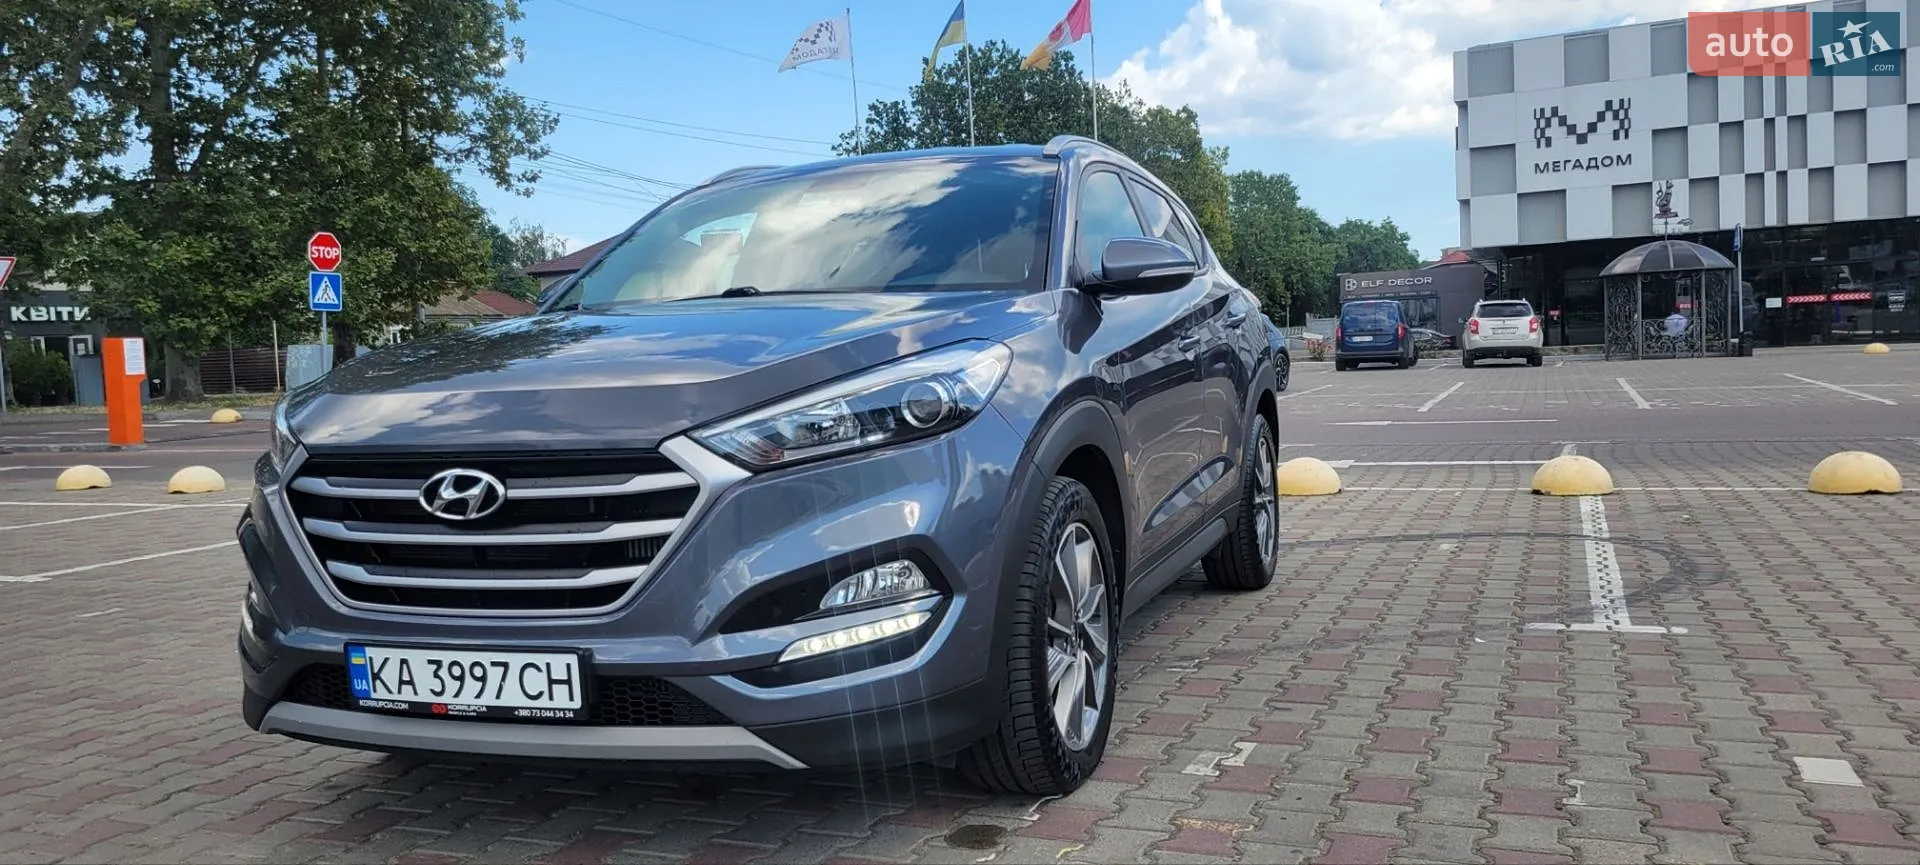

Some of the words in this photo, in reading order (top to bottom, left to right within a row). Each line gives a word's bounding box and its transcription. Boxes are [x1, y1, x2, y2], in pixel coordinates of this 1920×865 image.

[1534, 153, 1632, 174] МЕГАДОМ
[311, 245, 339, 259] STOP
[1361, 280, 1383, 288] ELF
[1388, 277, 1432, 286] DECOR
[354, 678, 368, 691] UA
[368, 656, 419, 697] KA
[427, 659, 510, 701] 3997
[518, 662, 574, 702] CH
[514, 709, 531, 717] +380
[531, 709, 540, 717] 73
[541, 710, 554, 718] 044
[555, 710, 564, 718] 34
[564, 710, 574, 718] 34
